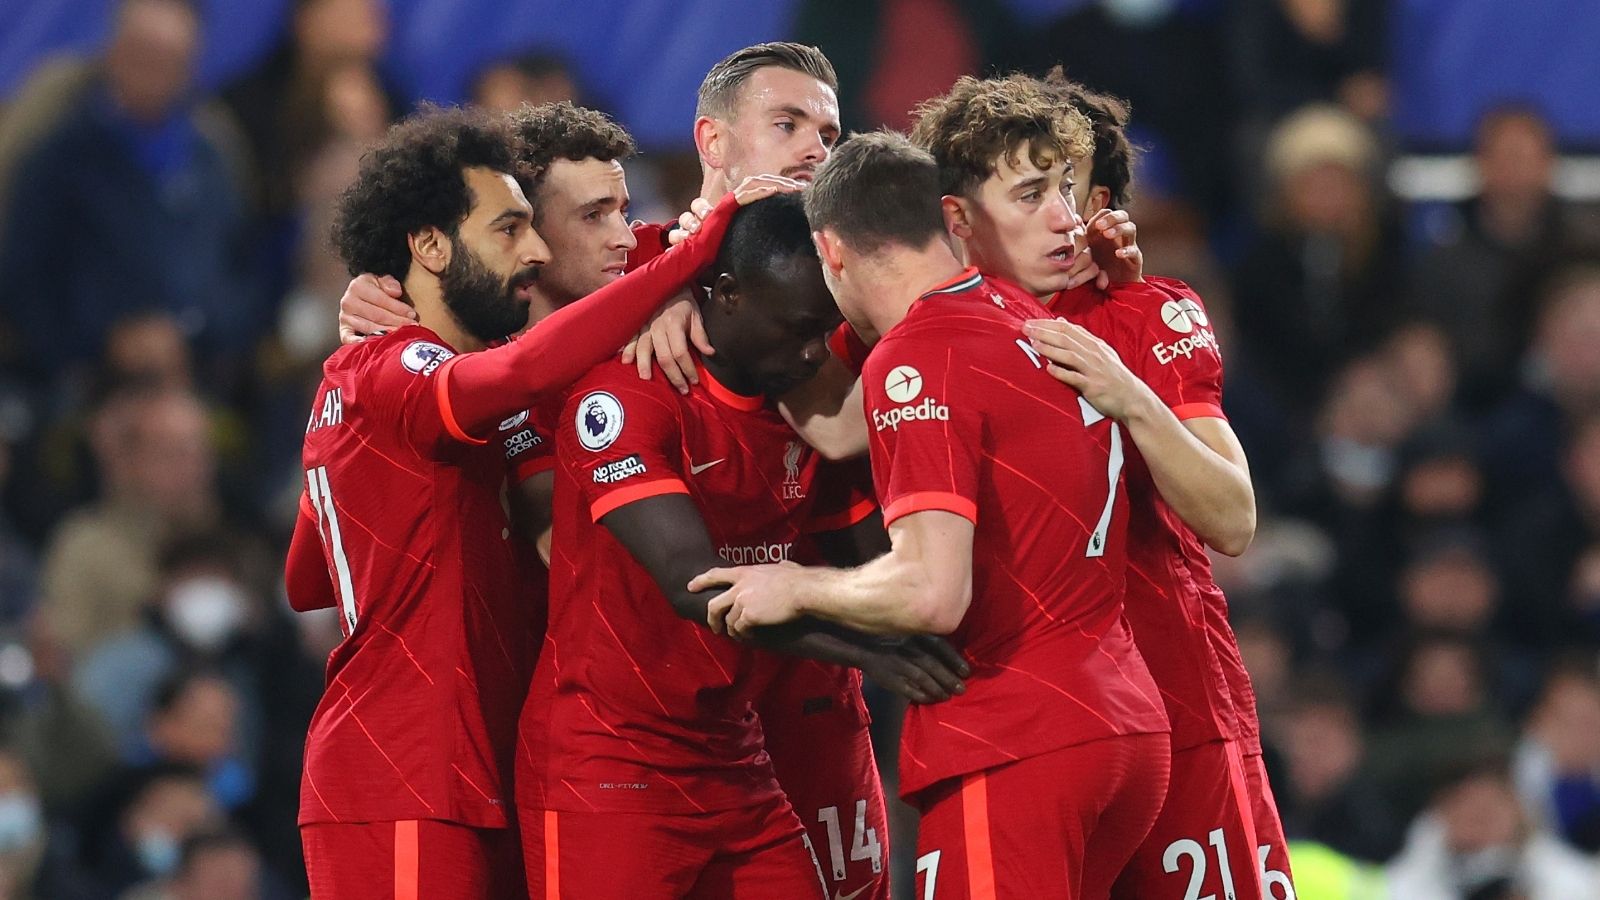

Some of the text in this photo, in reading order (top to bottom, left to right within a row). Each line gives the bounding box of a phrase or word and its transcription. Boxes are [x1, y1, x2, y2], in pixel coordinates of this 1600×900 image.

[873, 397, 949, 431] Expedia
[504, 430, 532, 447] oom
[593, 467, 608, 478] No
[719, 541, 792, 564] standar
[818, 800, 882, 881] 14
[1163, 828, 1236, 900] 21
